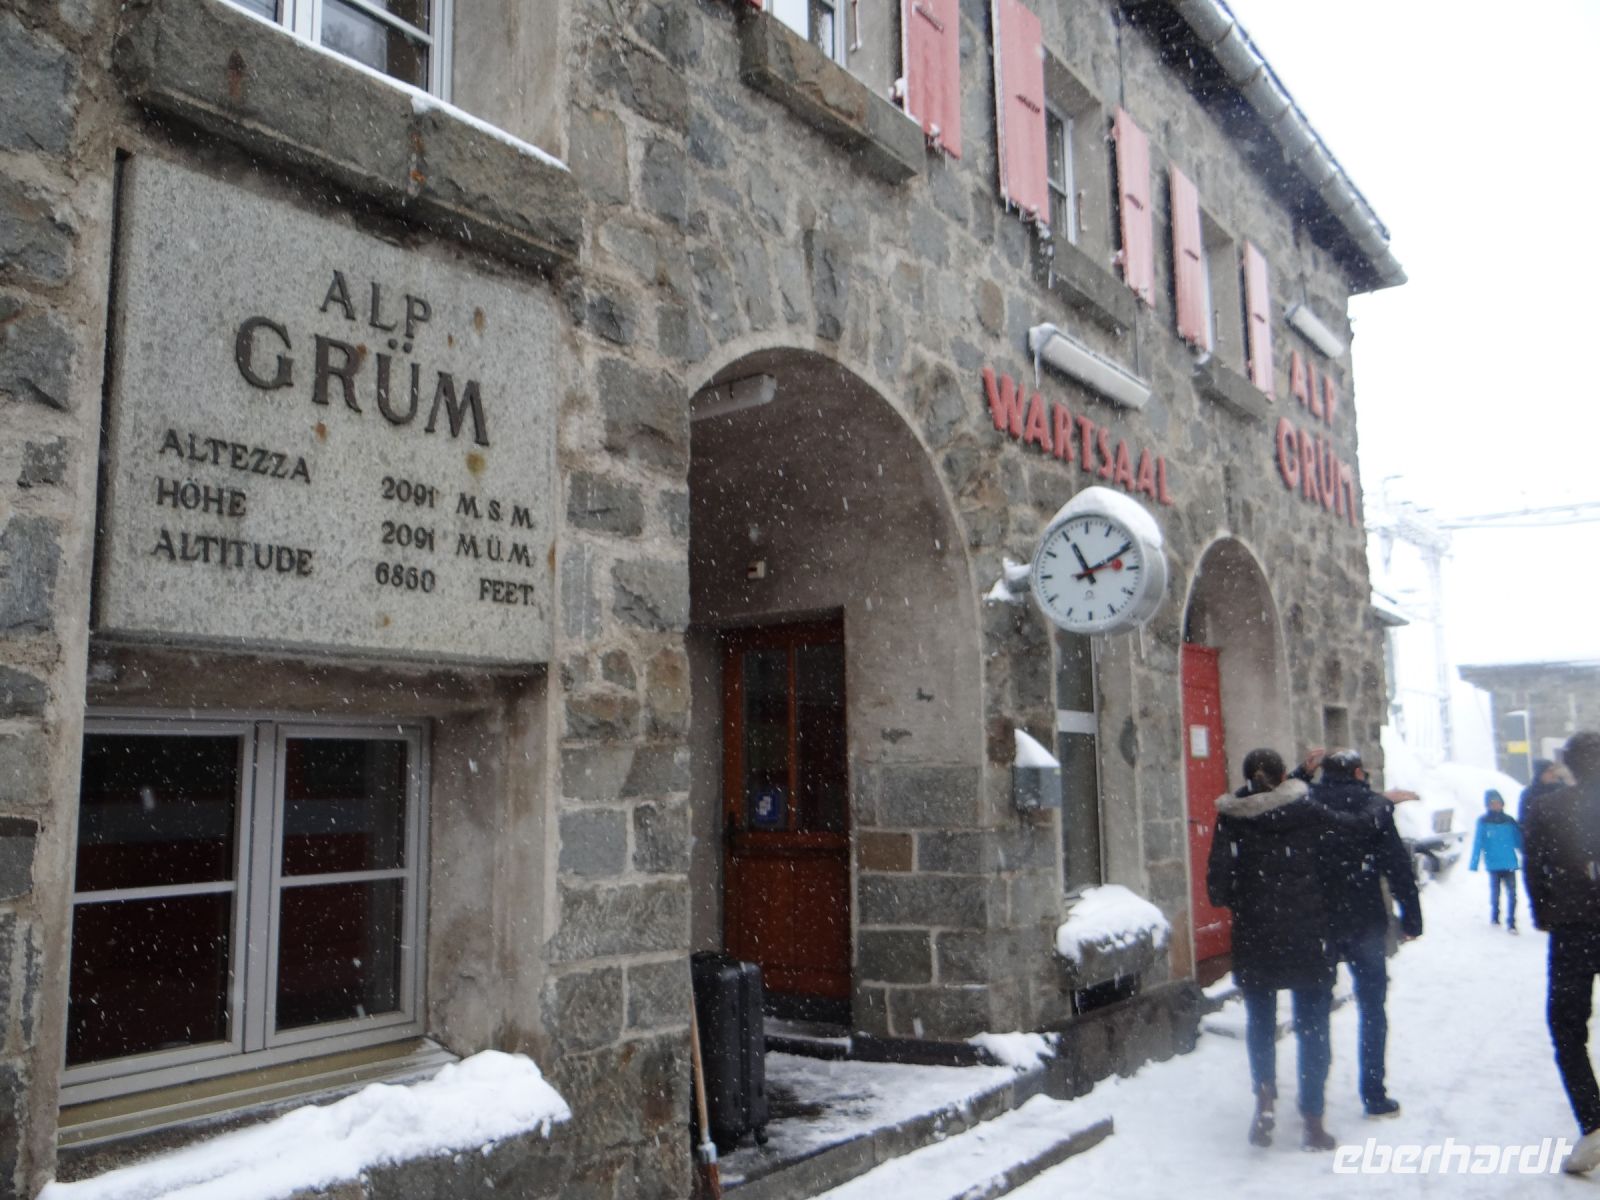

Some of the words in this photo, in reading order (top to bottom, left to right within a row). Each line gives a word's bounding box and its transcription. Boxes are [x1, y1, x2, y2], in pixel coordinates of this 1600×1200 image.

[320, 269, 432, 339] ALP
[235, 316, 490, 447] GRÜM
[1290, 350, 1337, 427] ALP
[159, 428, 311, 485] ALTEZZA
[381, 476, 436, 508] 2091
[982, 367, 1174, 507] WARTSAAL
[1276, 417, 1358, 529] GRÜM
[155, 475, 247, 517] HÖHE
[381, 520, 435, 551] 2091
[150, 529, 314, 577] ALTITUDE
